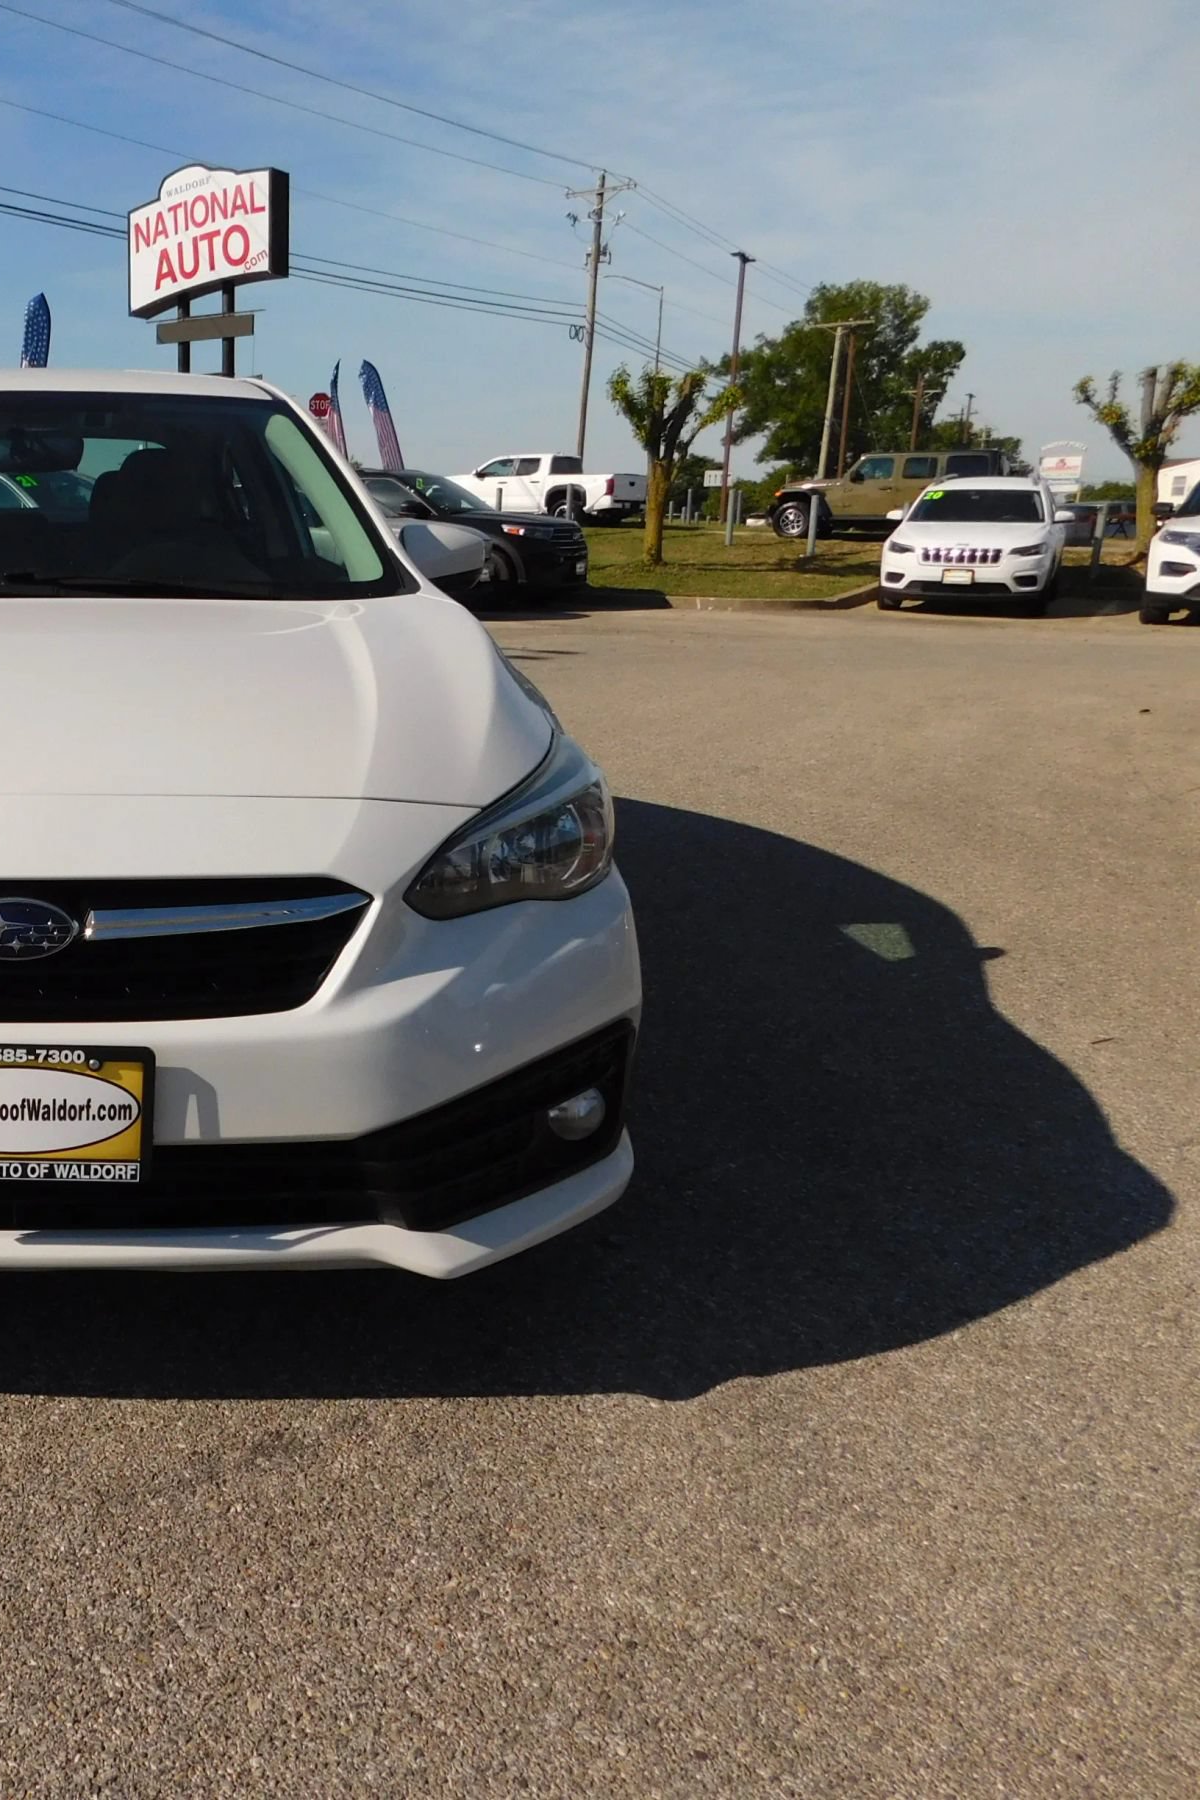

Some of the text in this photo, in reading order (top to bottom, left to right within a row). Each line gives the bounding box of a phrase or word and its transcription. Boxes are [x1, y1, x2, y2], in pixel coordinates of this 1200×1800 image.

[166, 175, 213, 199] WALDORF
[133, 181, 266, 254] NATIONAL
[154, 224, 268, 291] AUTO .com
[15, 475, 38, 488] 21
[27, 1163, 49, 1179] OF
[54, 1164, 138, 1180] WALDORF
